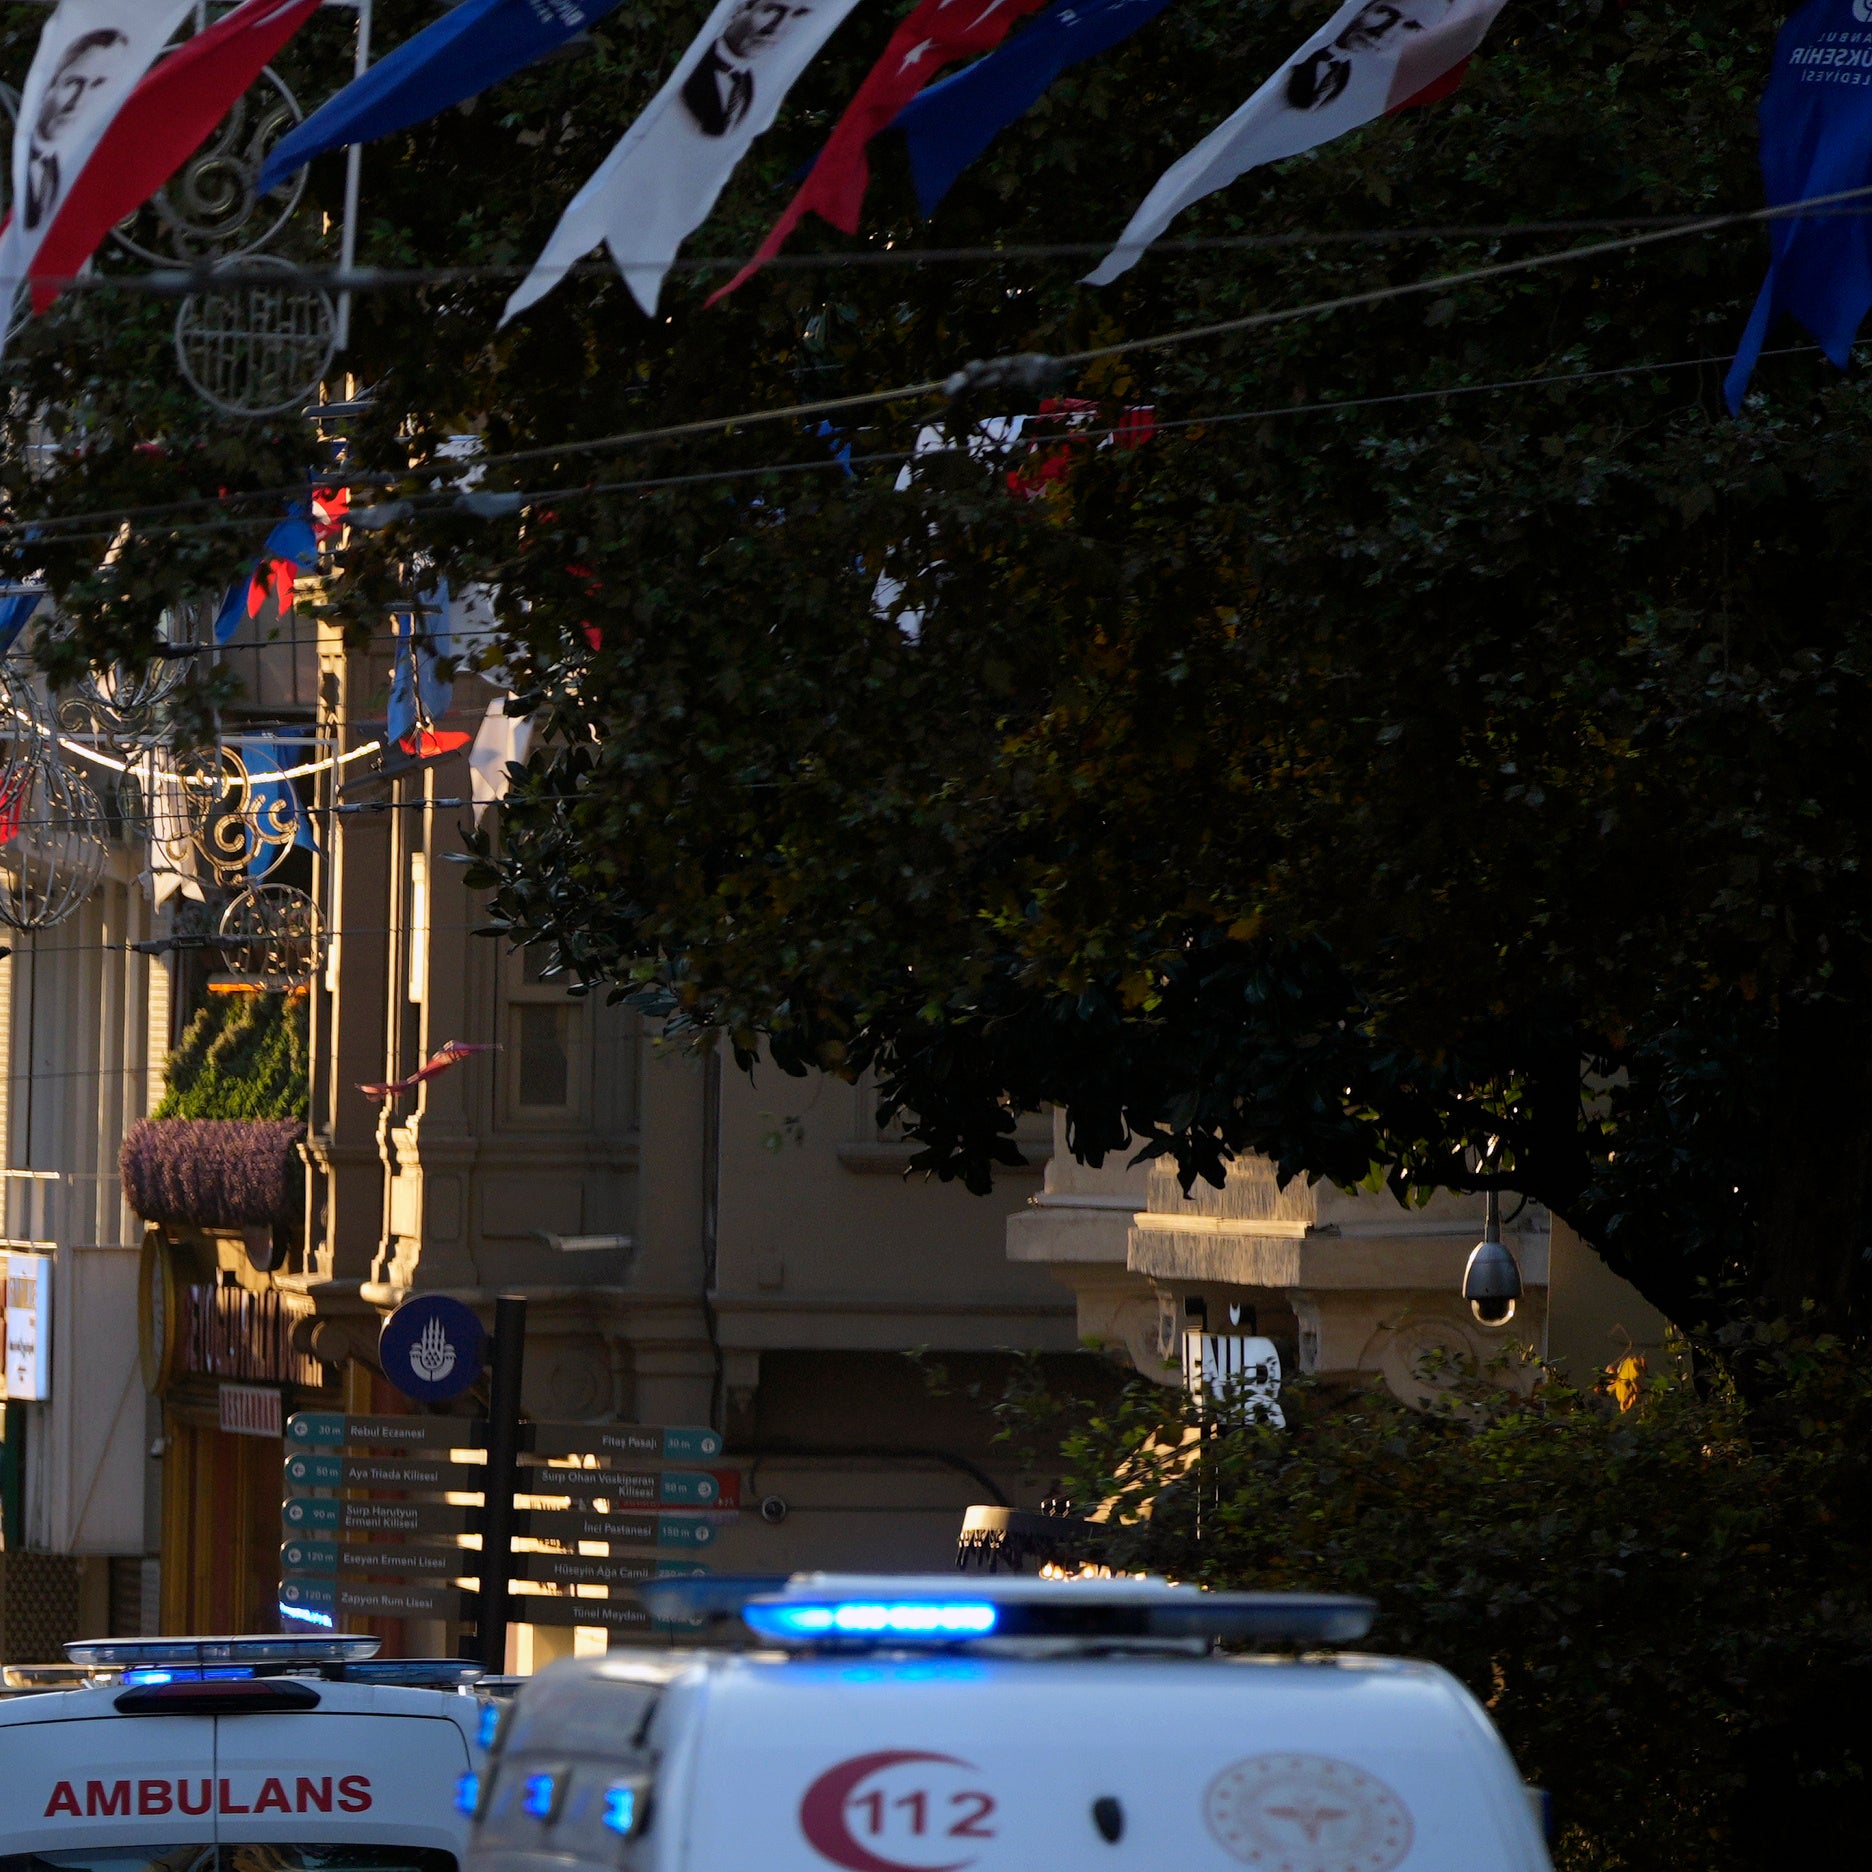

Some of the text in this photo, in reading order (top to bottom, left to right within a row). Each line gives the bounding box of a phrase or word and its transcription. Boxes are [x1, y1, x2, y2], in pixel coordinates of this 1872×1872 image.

[332, 1427, 340, 1435] m
[330, 1468, 339, 1476] m
[348, 1467, 368, 1480] Aya
[370, 1467, 401, 1480] Triada
[346, 1504, 370, 1517] Surp
[344, 1515, 381, 1527] Ermeni
[325, 1554, 334, 1562] m
[343, 1552, 379, 1567] Eseyan
[380, 1555, 416, 1567] Ermeni
[323, 1593, 332, 1601] m
[341, 1592, 379, 1608] Zapyon
[381, 1596, 404, 1607] Rum
[43, 1774, 373, 1817] AMBULANS
[854, 1788, 997, 1838] 112
